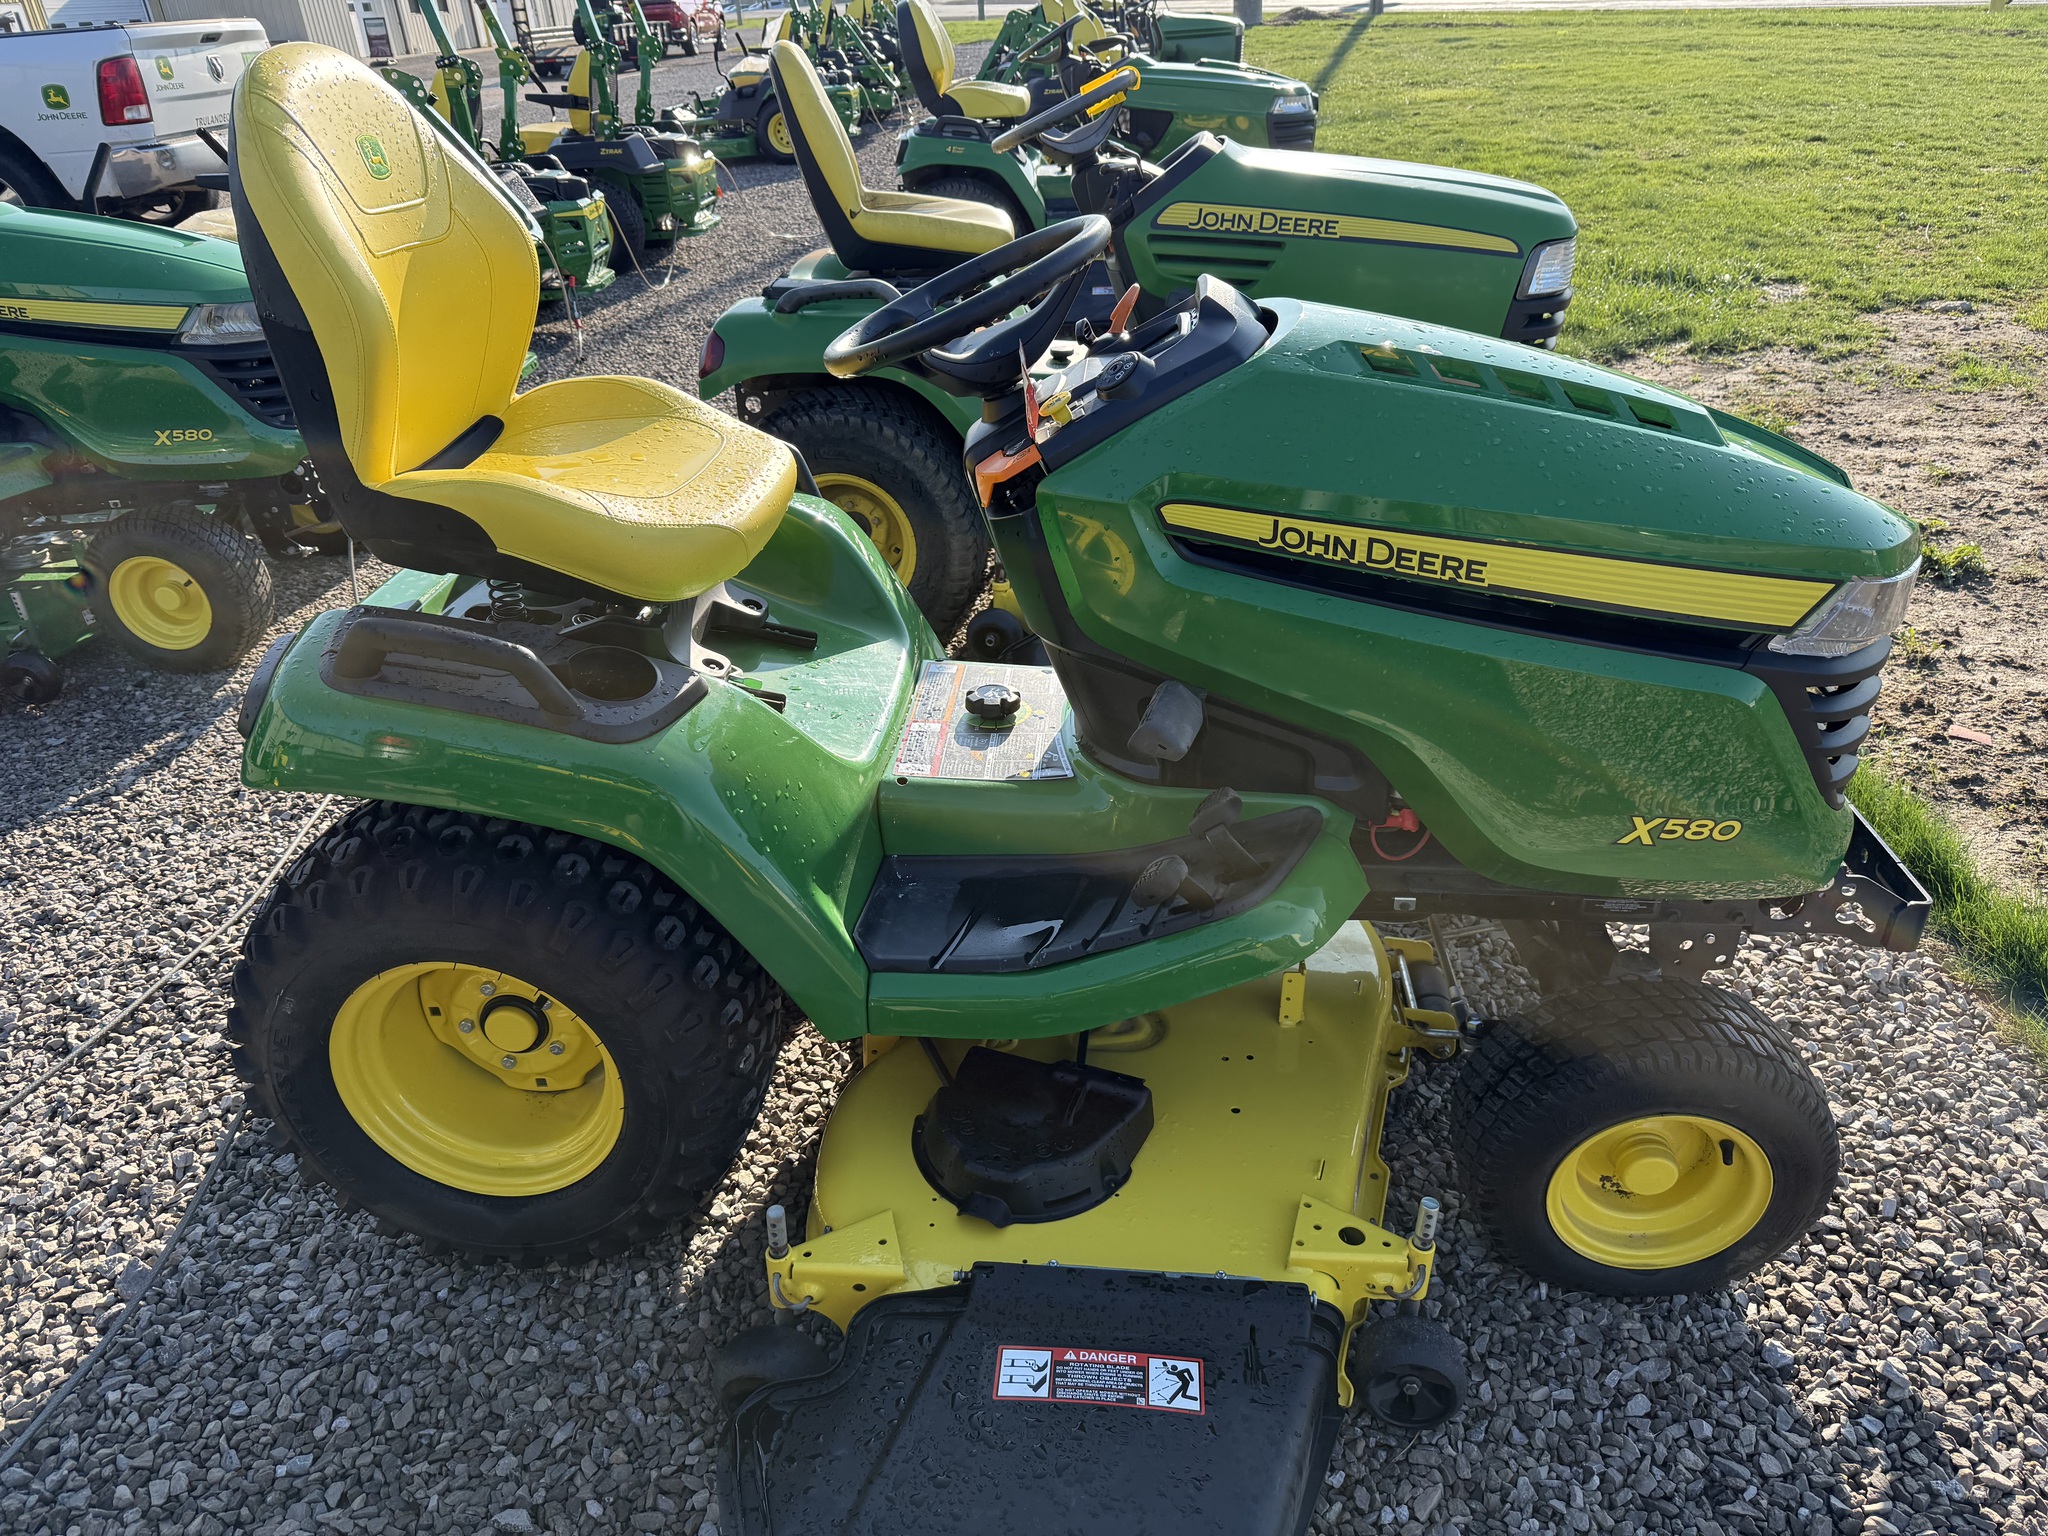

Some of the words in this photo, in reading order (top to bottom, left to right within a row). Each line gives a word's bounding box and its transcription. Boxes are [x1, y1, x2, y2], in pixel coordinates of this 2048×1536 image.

[155, 84, 169, 92] JOHN
[169, 82, 186, 90] DEERE
[37, 112, 59, 121] JOHN
[59, 111, 88, 120] DEERE
[1188, 208, 1254, 230] JOHN
[1258, 211, 1339, 236] DEERE
[153, 429, 214, 446] X580
[1258, 519, 1357, 560] JOHN
[1365, 536, 1488, 583] DEERE
[1615, 816, 1743, 846] X580
[1079, 1351, 1137, 1364] DANGER
